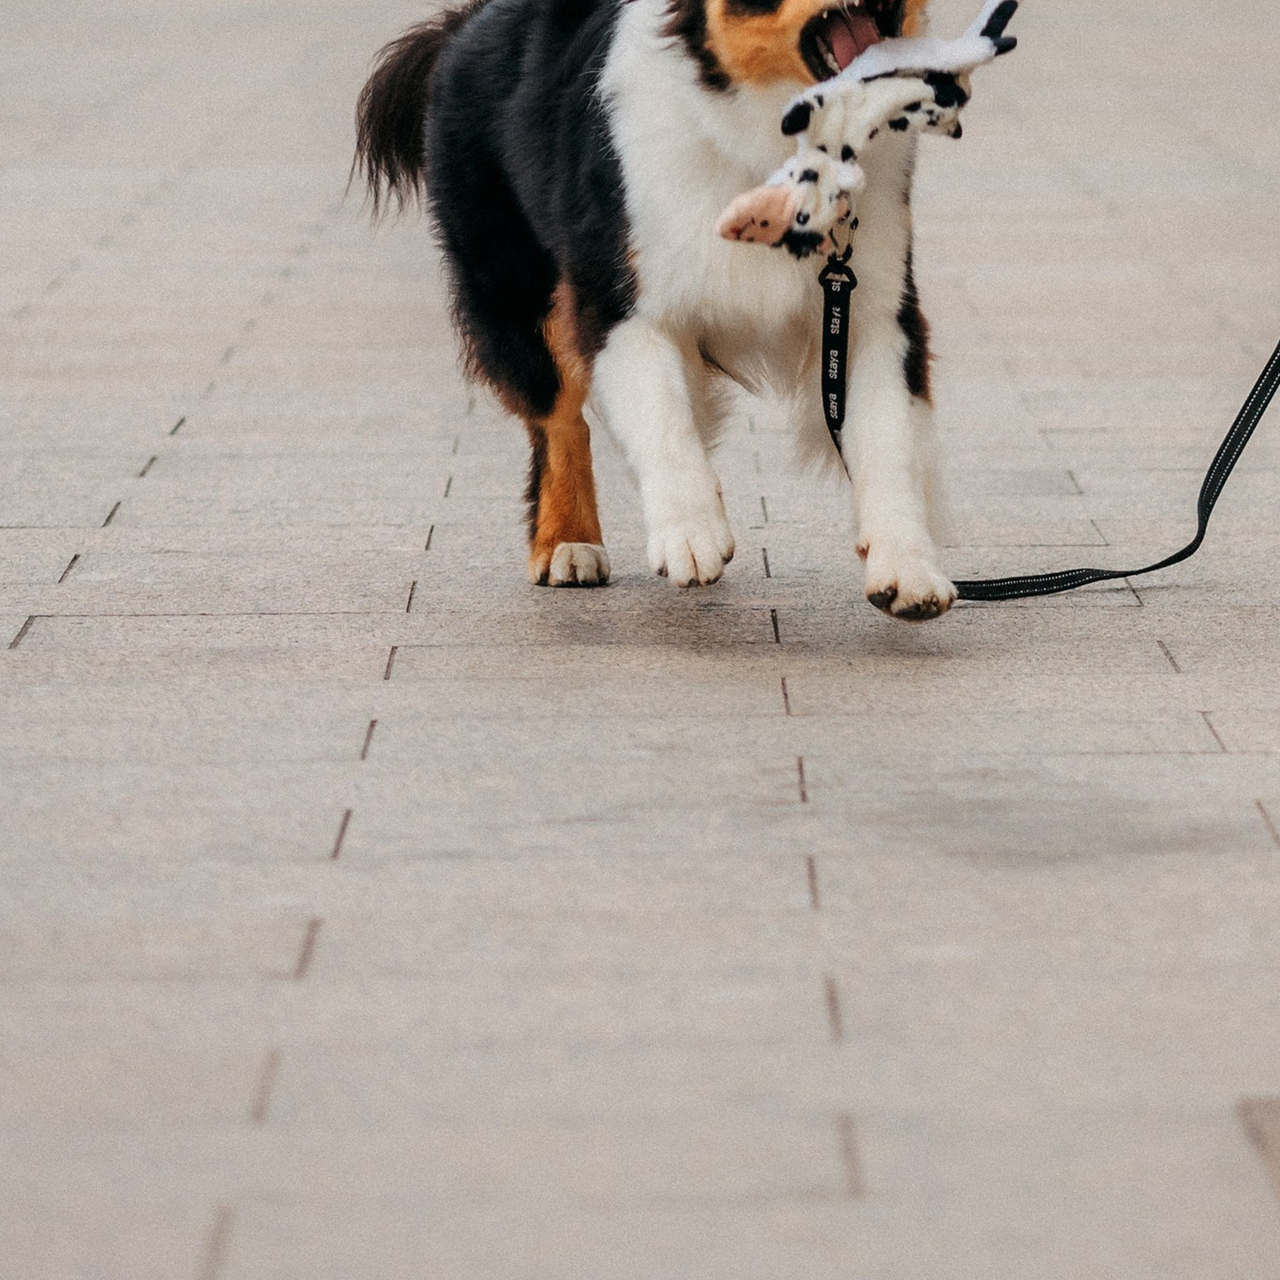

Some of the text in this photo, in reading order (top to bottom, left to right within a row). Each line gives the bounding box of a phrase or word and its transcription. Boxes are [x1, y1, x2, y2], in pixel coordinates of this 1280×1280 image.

[831, 281, 841, 292] st
[828, 349, 839, 380] staya
[828, 393, 838, 419] staya
